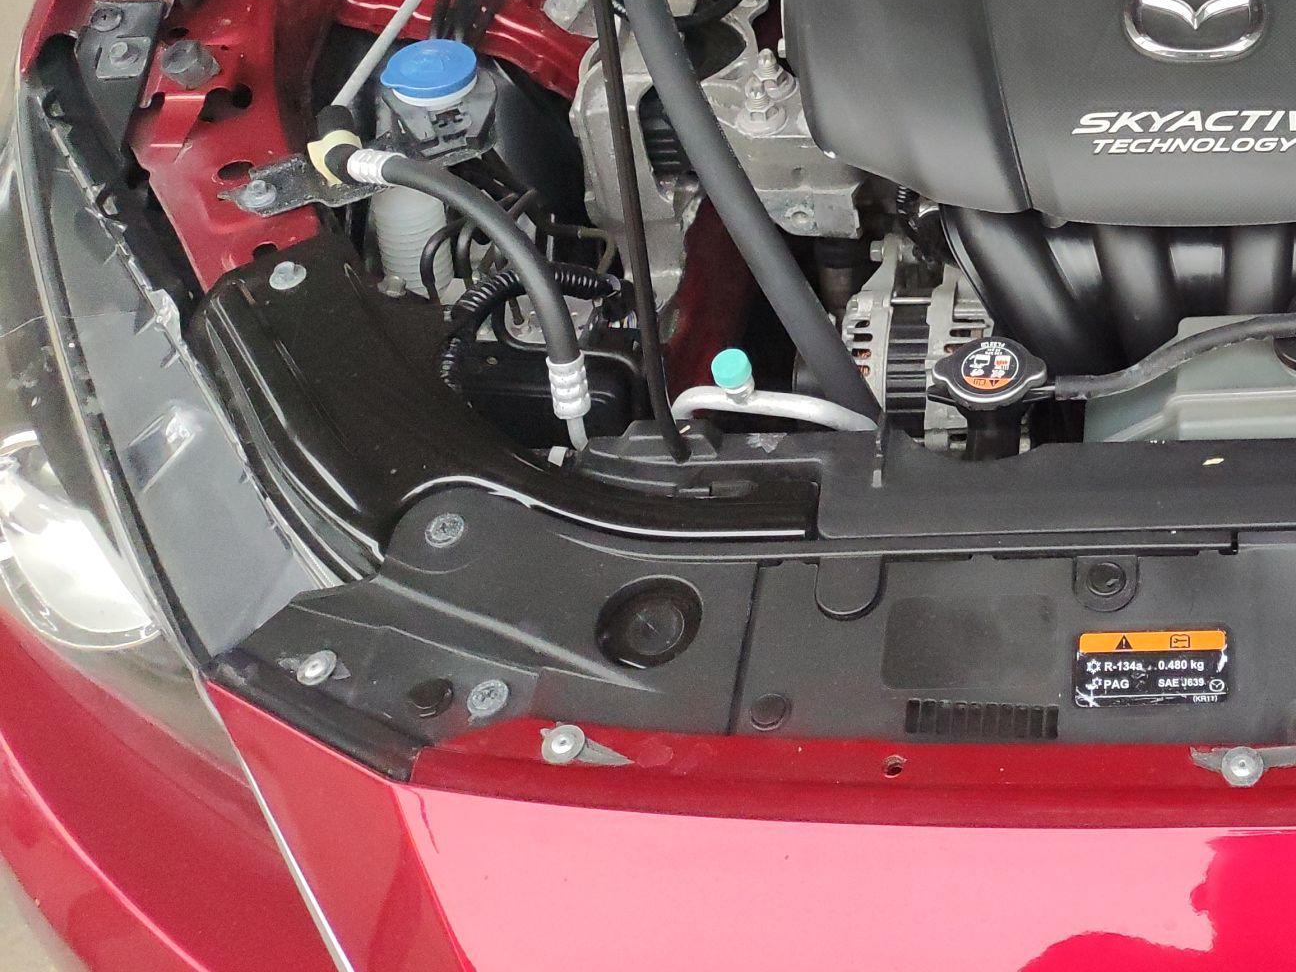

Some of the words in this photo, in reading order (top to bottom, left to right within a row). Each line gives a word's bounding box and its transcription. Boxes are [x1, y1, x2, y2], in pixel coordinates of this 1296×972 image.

[1103, 661, 1143, 672] R-134a
[1157, 660, 1188, 671] 0.480
[1190, 659, 1205, 672] kg
[1103, 678, 1130, 690] PAG
[1158, 677, 1180, 688] SAE
[1181, 677, 1205, 688] J639
